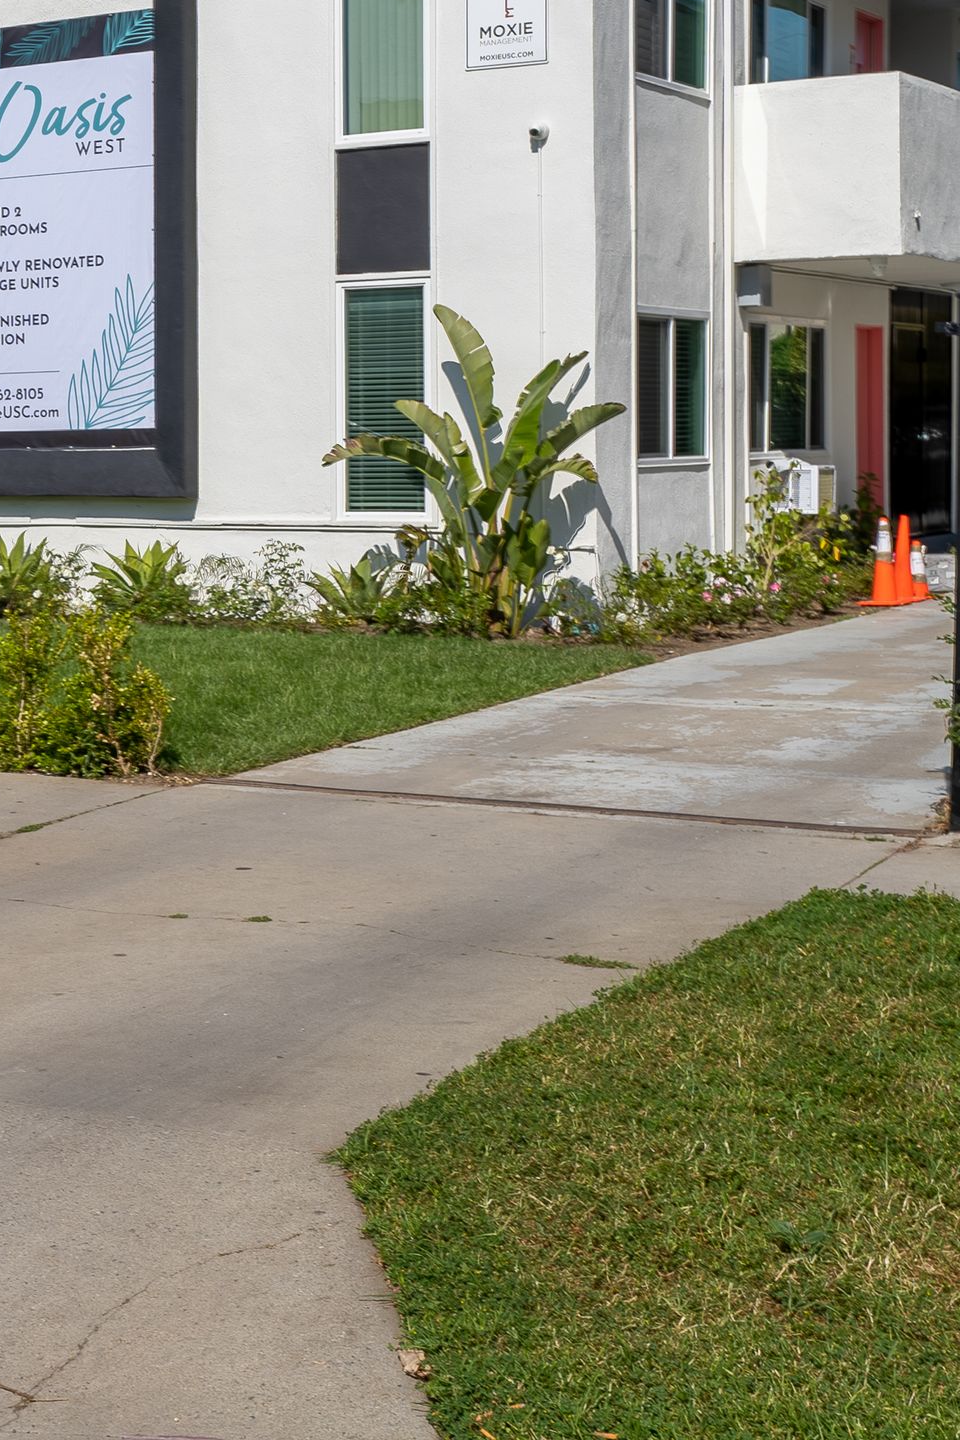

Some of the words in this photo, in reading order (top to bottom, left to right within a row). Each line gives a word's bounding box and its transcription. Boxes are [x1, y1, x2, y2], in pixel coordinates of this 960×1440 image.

[479, 22, 533, 39] MOXIE
[479, 35, 533, 47] MANAGEMENT
[479, 51, 534, 62] MOXIEUSC.COM
[75, 137, 125, 156] WEST
[14, 206, 22, 218] 2
[25, 255, 105, 272] RENOVATED
[20, 276, 59, 290] UNITS
